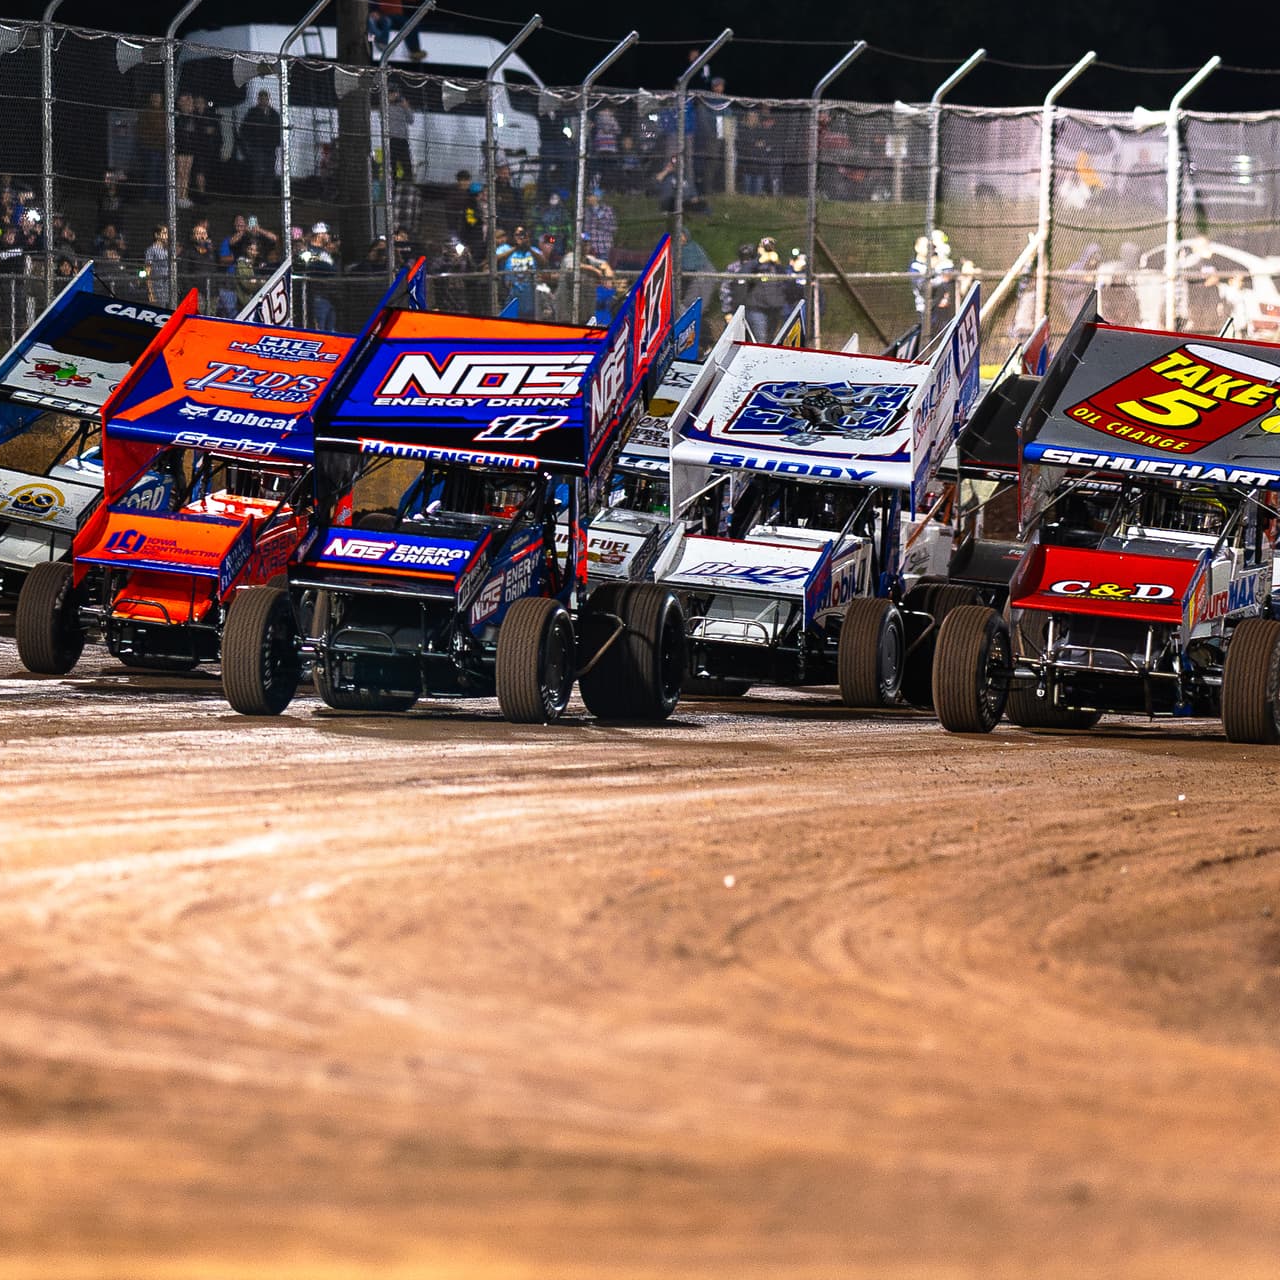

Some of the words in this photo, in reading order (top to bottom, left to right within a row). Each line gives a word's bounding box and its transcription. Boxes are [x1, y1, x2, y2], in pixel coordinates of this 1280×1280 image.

[231, 341, 340, 361] HAWKEYE
[185, 361, 327, 393] TED'S
[378, 353, 596, 396] NOS
[1150, 352, 1279, 408] TAKE
[373, 397, 482, 407] ENERGY
[486, 398, 571, 407] DRINK
[1116, 389, 1218, 427] 5
[213, 409, 297, 431] Bobcat
[473, 416, 569, 441] 17
[1073, 407, 1098, 425] OIL
[1106, 421, 1191, 451] CHANGE
[361, 441, 537, 468] HAUDENSCHILD
[708, 453, 878, 481] BUDDY
[1040, 448, 1280, 486] SCHUCHART
[146, 537, 177, 546] IOWA
[323, 539, 396, 559] NOS
[589, 538, 630, 553] FUEL
[388, 552, 455, 567] DRINK
[1051, 580, 1174, 600] C&D
